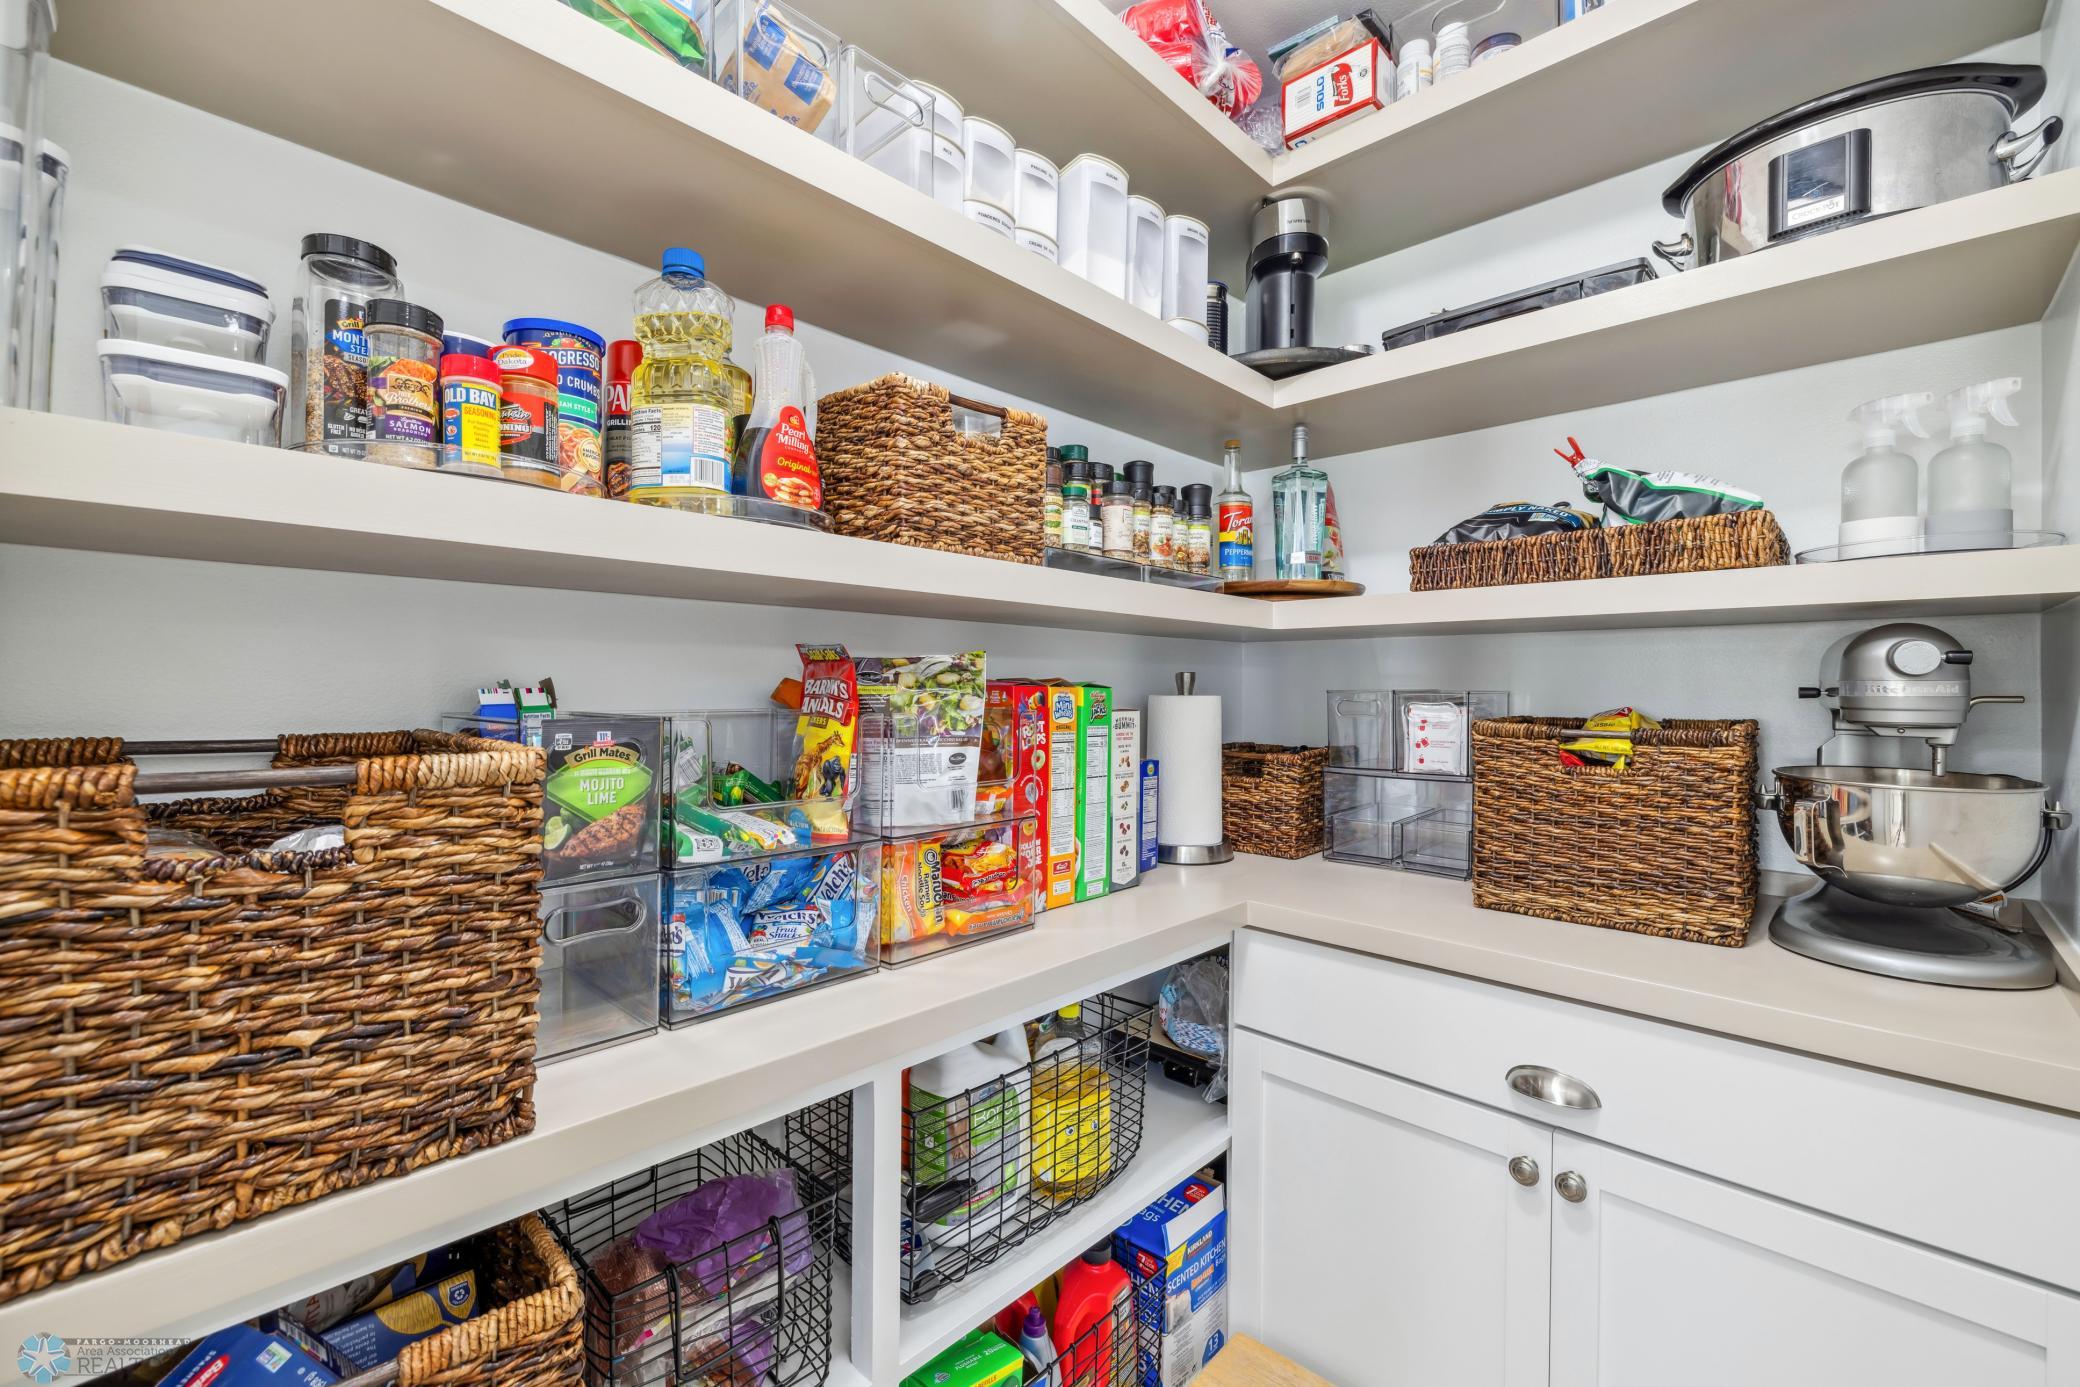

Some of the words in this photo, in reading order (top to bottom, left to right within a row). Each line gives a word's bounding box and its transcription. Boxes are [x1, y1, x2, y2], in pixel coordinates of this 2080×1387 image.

[1316, 75, 1325, 111] SOLO
[1338, 74, 1350, 102] Forks
[332, 329, 369, 346] MONT
[497, 357, 528, 366] Dakota
[500, 352, 521, 360] Pride
[445, 388, 466, 403] OLD
[567, 375, 601, 400] CRUMBS
[464, 406, 497, 420] SEASONING
[574, 403, 592, 414] STYLE
[389, 419, 432, 435] SALMON
[393, 427, 428, 437] SEASONING
[780, 422, 807, 438] Pearl
[775, 432, 809, 454] Milling
[777, 456, 812, 475] Original
[1865, 685, 1960, 695] KitchenAid
[1054, 700, 1074, 711] Mini
[1114, 722, 1135, 730] SUMMIT
[1021, 733, 1047, 751] LOOPS
[573, 750, 597, 763] Grill
[599, 747, 631, 761] Mates
[579, 777, 625, 793] MOJITO
[587, 792, 617, 806] LIME
[916, 861, 925, 893] Noodle
[901, 875, 912, 913] Chicken
[930, 860, 944, 923] Maruchan
[768, 931, 802, 940] Snacks
[775, 926, 798, 935] Fruit
[1185, 1183, 1198, 1197] 7
[1187, 1230, 1213, 1255] KIRKLAND
[1166, 1262, 1199, 1294] SCENTED
[1199, 1237, 1227, 1273] KITCHEN
[1208, 1332, 1220, 1352] 13
